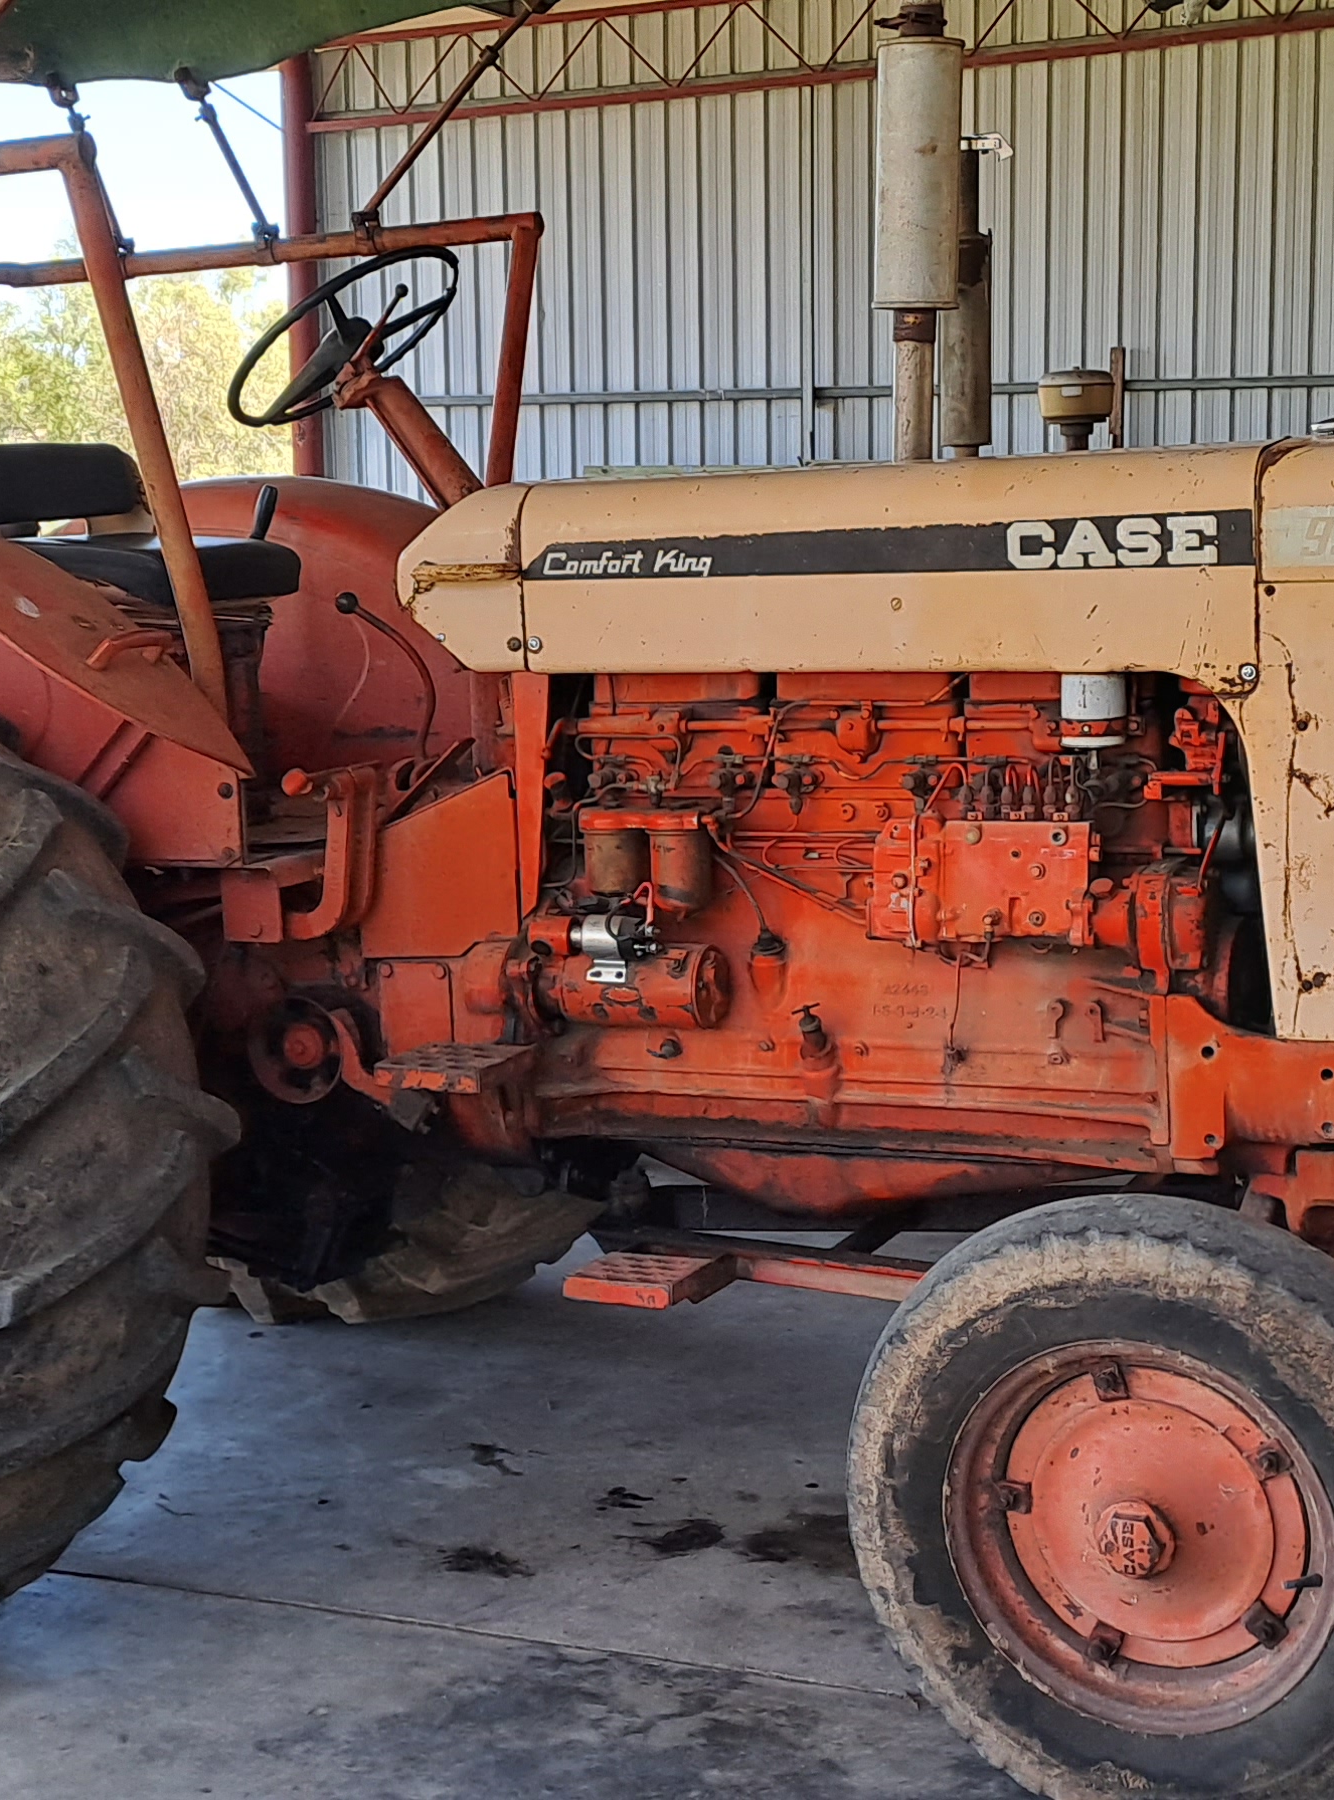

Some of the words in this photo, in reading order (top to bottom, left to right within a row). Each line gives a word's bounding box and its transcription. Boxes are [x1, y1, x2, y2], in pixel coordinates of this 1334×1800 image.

[542, 550, 643, 576] Comfort
[653, 549, 712, 577] King
[1006, 514, 1218, 570] CASE
[1121, 1521, 1137, 1576] CASE
